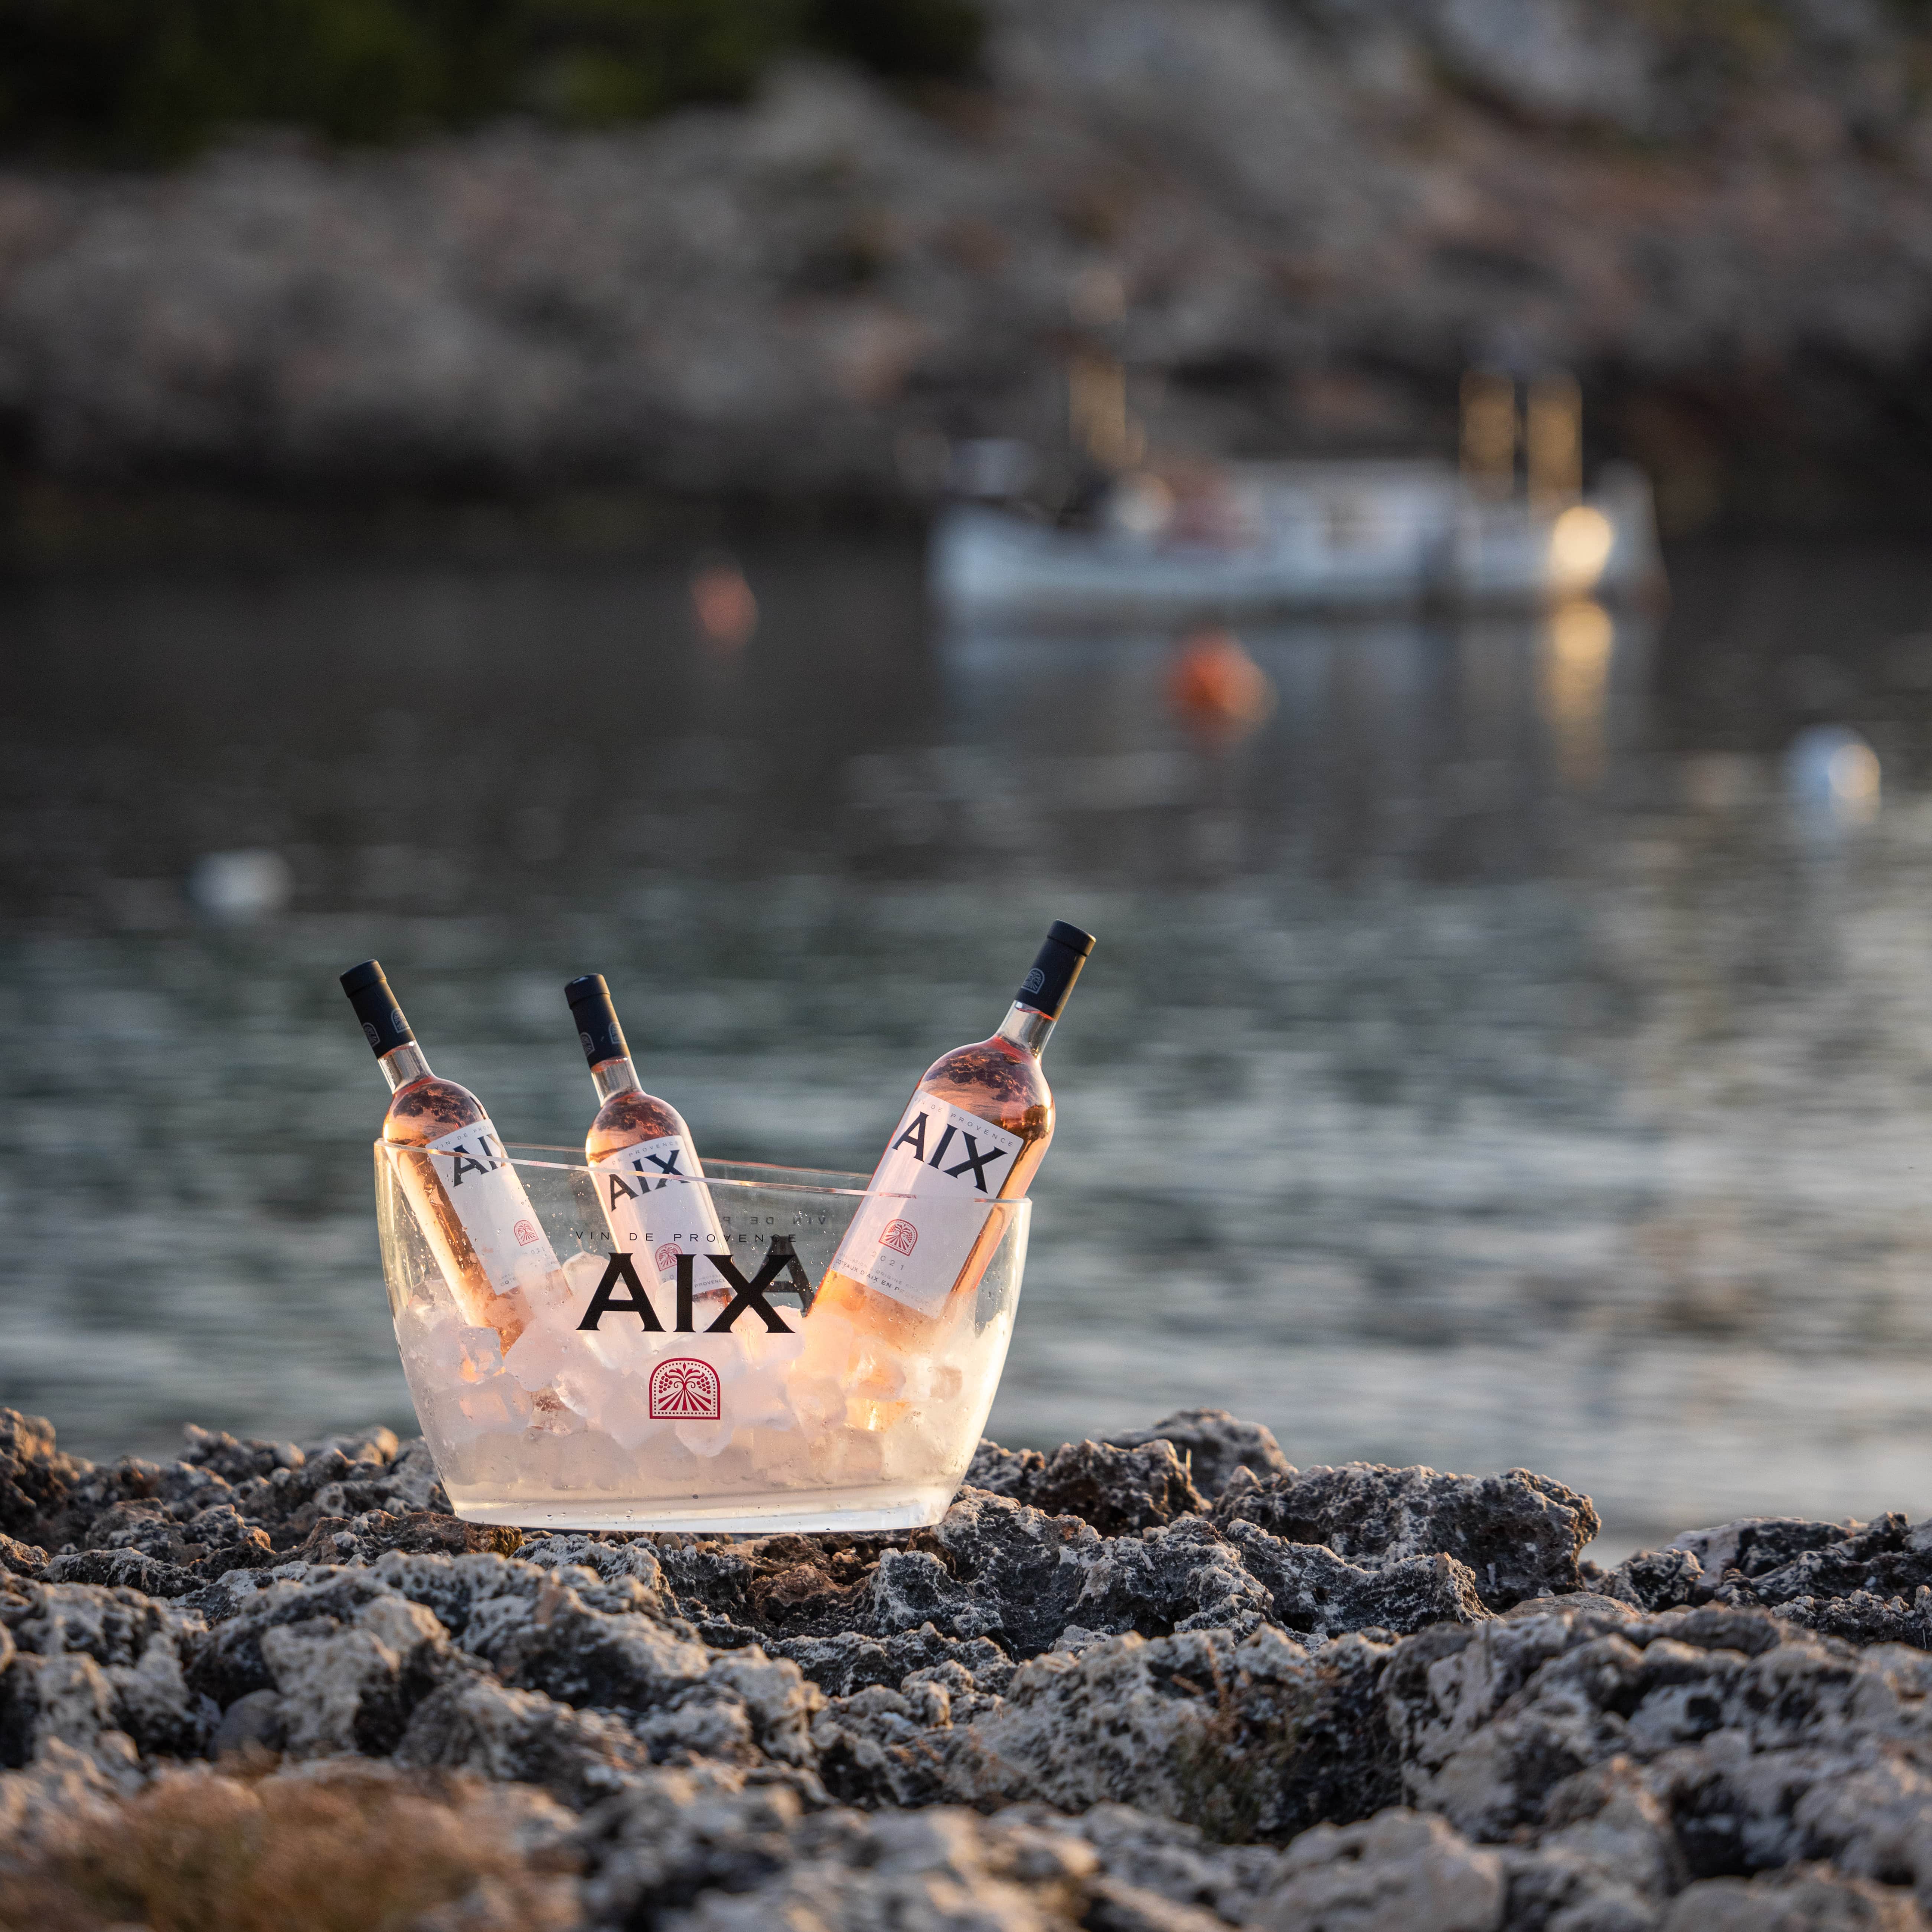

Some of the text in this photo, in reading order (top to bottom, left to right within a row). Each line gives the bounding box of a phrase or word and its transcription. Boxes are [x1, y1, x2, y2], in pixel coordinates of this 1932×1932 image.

[931, 1104, 943, 1113] DE
[950, 1113, 1014, 1147] PROVENCE
[435, 1140, 451, 1150] VIN
[892, 1111, 1008, 1194] AIX
[608, 1149, 691, 1212] AIX
[575, 1231, 796, 1243] VIN DE PROVENCE
[871, 1251, 904, 1270] 2021
[575, 1252, 796, 1334] AIX
[860, 1270, 879, 1282] D'AIX
[881, 1280, 892, 1288] EN
